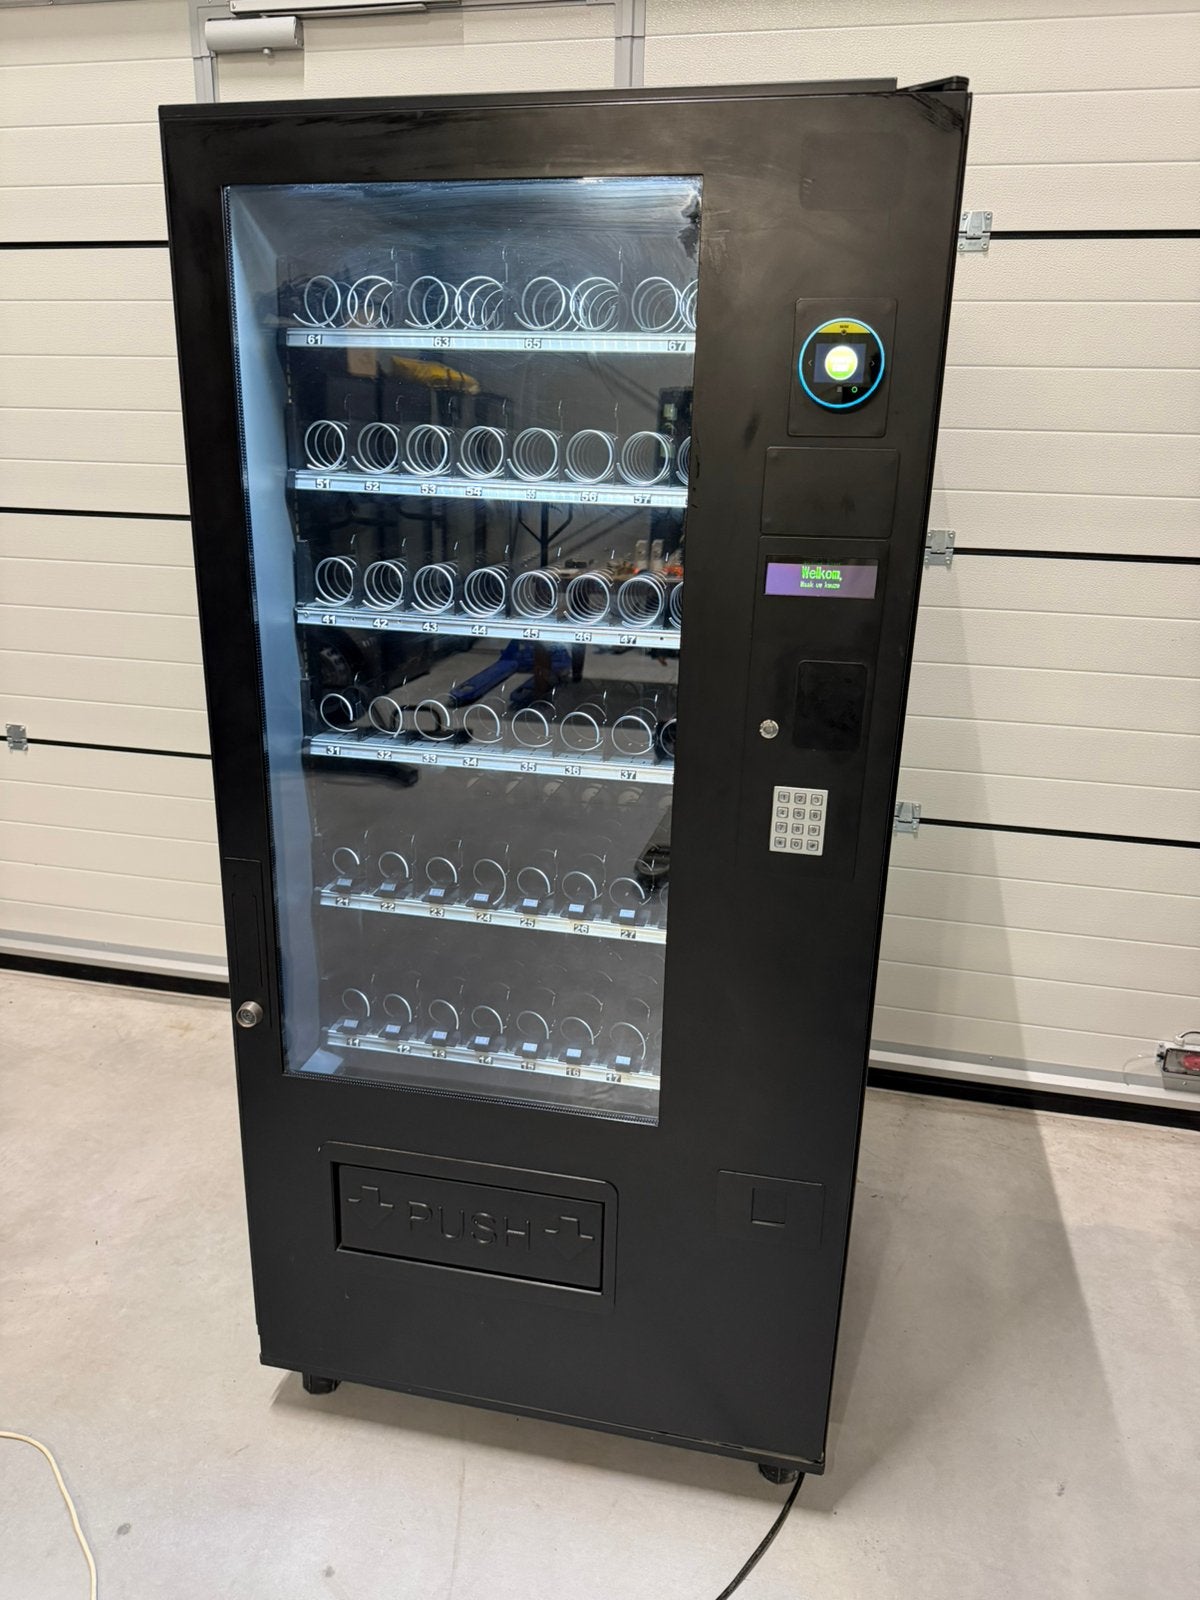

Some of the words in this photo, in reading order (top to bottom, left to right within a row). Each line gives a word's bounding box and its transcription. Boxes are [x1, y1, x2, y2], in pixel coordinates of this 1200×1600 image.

[307, 335, 321, 344] 61
[434, 337, 450, 346] 63
[525, 339, 541, 348] 65
[669, 341, 685, 350] 67
[316, 479, 330, 488] 51
[365, 482, 380, 491] 52
[421, 485, 436, 494] 53
[466, 487, 482, 496] 54
[527, 490, 535, 498] 55
[581, 492, 597, 502] 56
[634, 495, 651, 504] 57
[322, 615, 335, 624] 41
[373, 619, 388, 628] 42
[423, 623, 438, 631] 43
[472, 626, 487, 635] 44
[524, 629, 539, 638] 45
[576, 633, 591, 641] 46
[620, 635, 636, 644] 47
[327, 746, 340, 755] 31
[378, 751, 391, 759] 32
[423, 754, 437, 763] 33
[463, 758, 478, 767] 34
[521, 763, 536, 771] 35
[565, 766, 580, 774] 36
[621, 770, 636, 779] 37
[381, 903, 395, 911] 22
[430, 908, 444, 917] 23
[477, 913, 491, 922] 24
[520, 919, 535, 927] 25
[574, 925, 588, 933] 26
[621, 929, 636, 938] 27
[398, 1045, 410, 1053] 12
[433, 1050, 446, 1058] 13
[479, 1055, 493, 1064] 14
[521, 1062, 535, 1070] 15
[567, 1068, 580, 1077] 16
[607, 1074, 621, 1082] 17
[409, 1201, 530, 1250] PUSH
